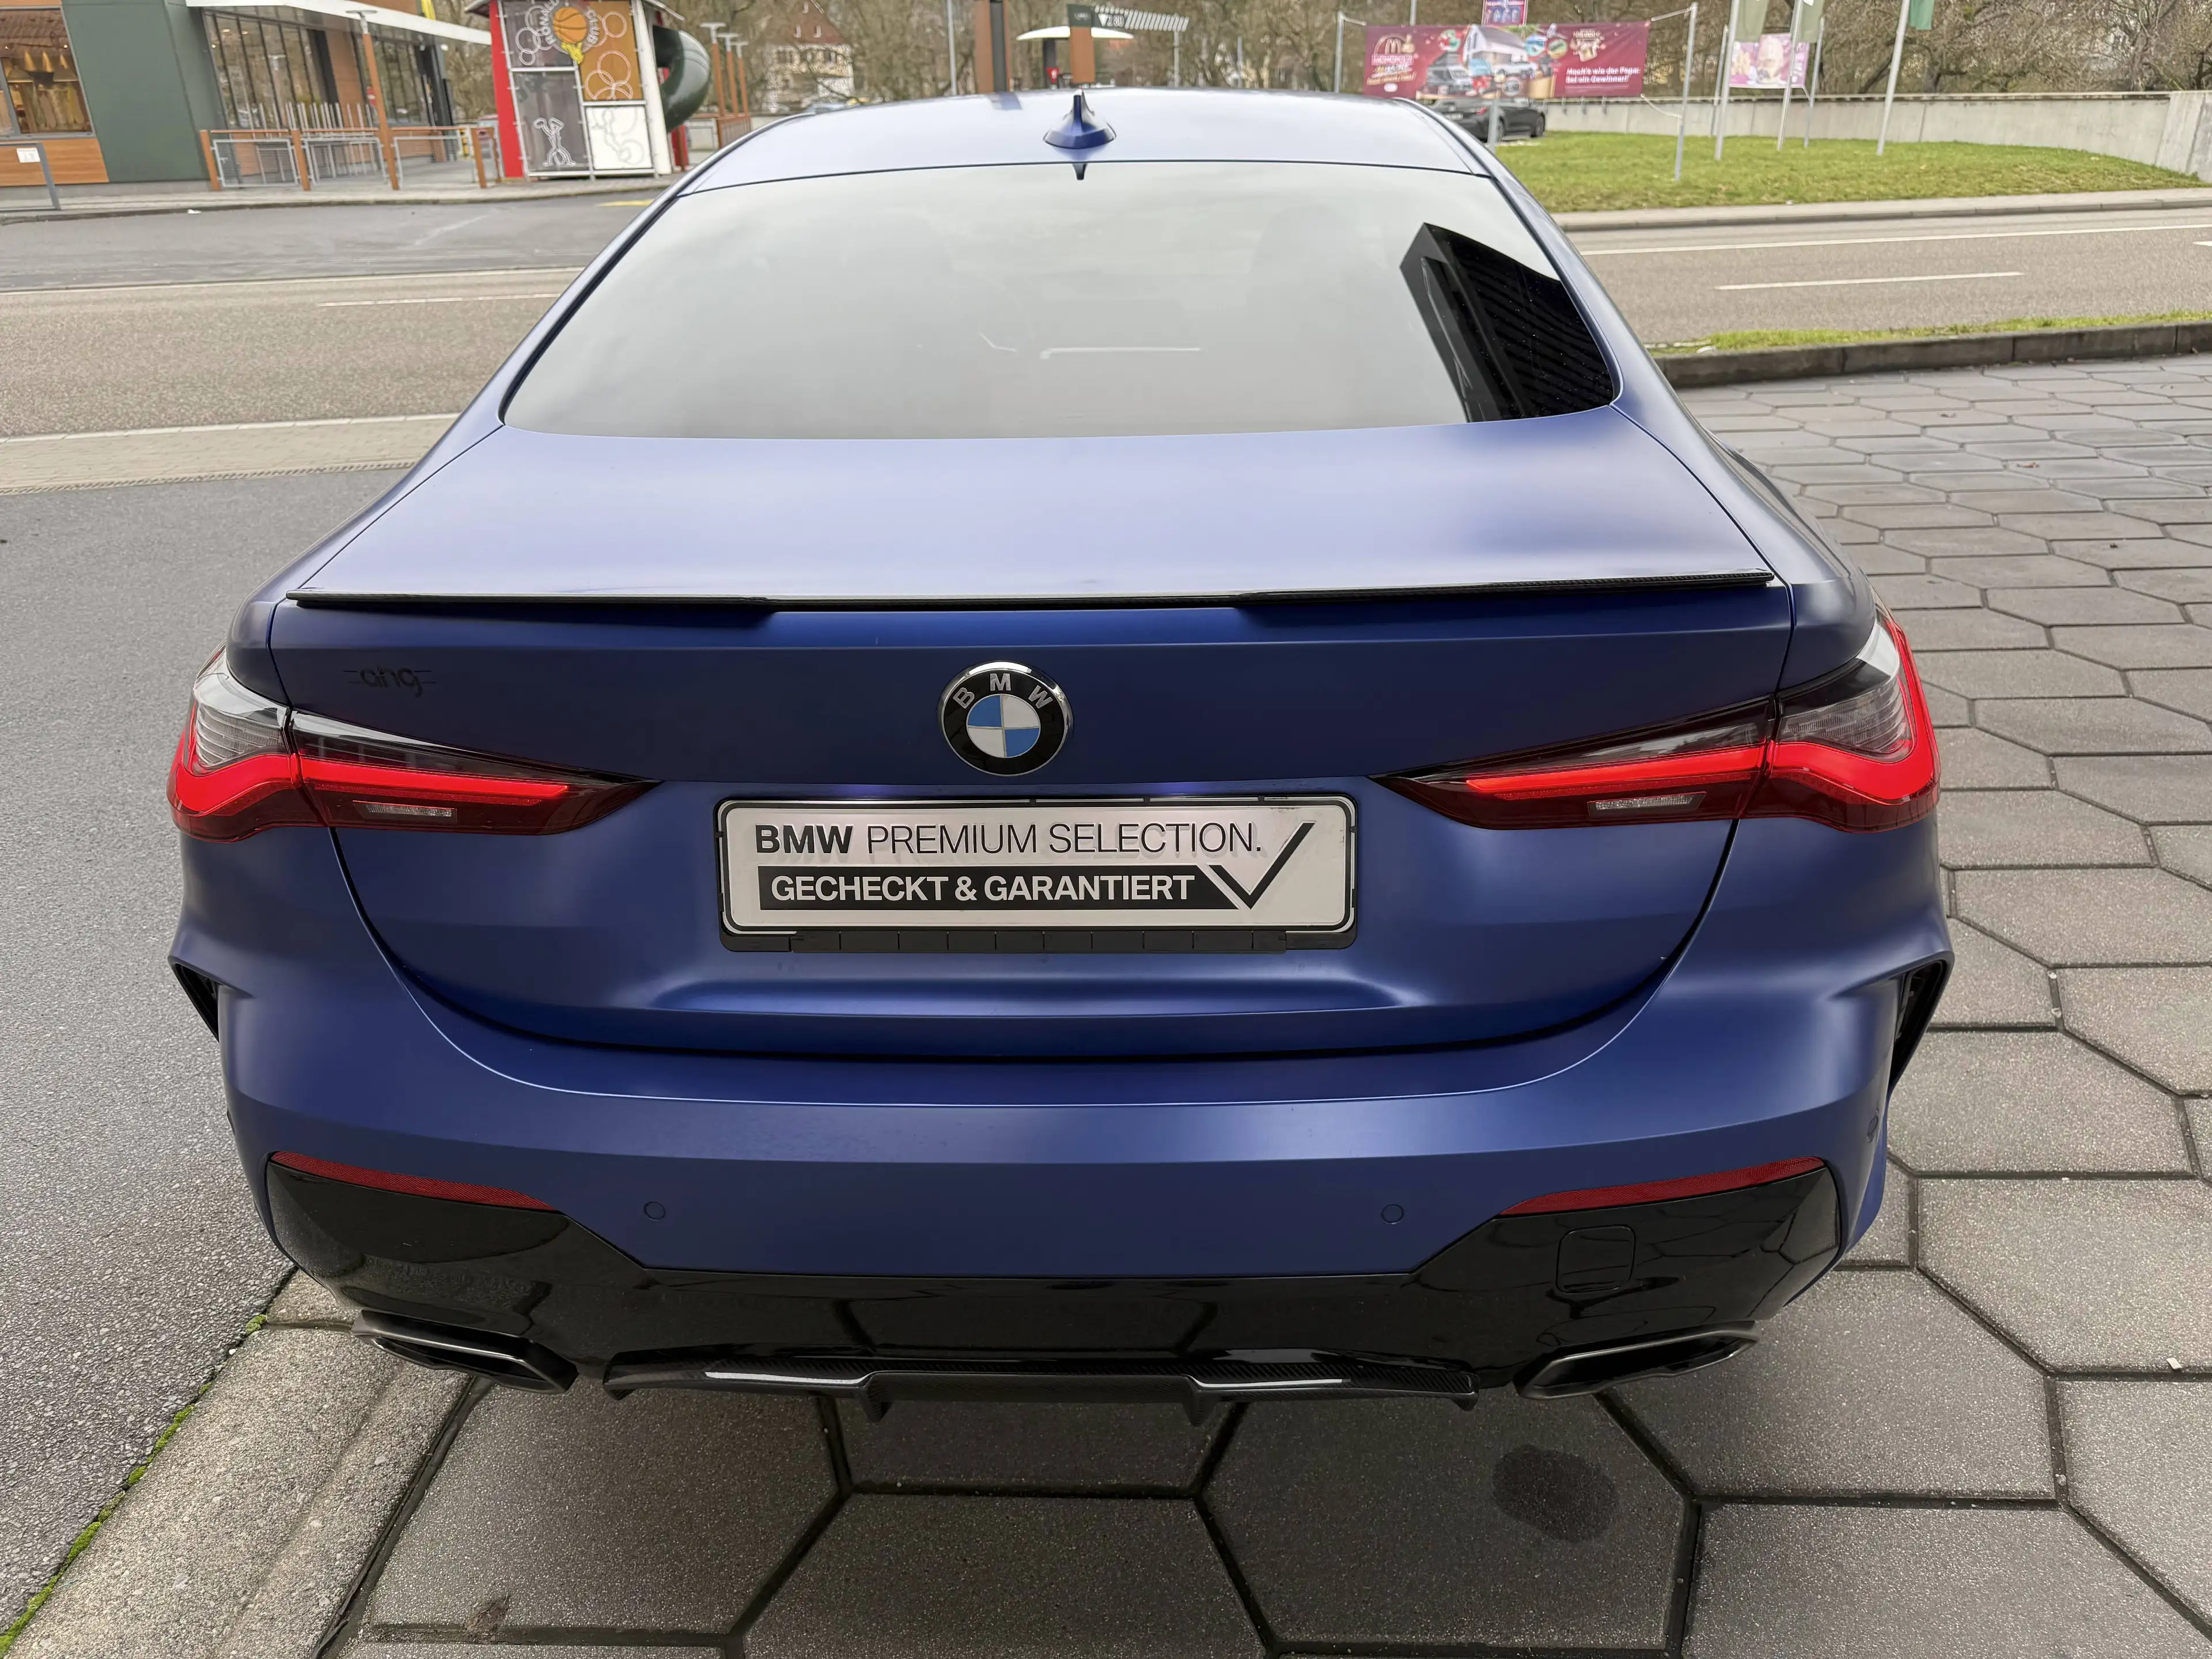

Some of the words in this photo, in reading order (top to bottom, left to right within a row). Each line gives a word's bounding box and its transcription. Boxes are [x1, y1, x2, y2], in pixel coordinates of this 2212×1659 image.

[953, 673, 1053, 709] BMW
[755, 824, 853, 854] BMW
[868, 824, 1036, 854] PREMIUM
[1049, 823, 1262, 853] SELECTION.
[771, 876, 948, 901] GECHECKT
[955, 876, 977, 901] &
[984, 875, 1195, 900] GARANTIERT
